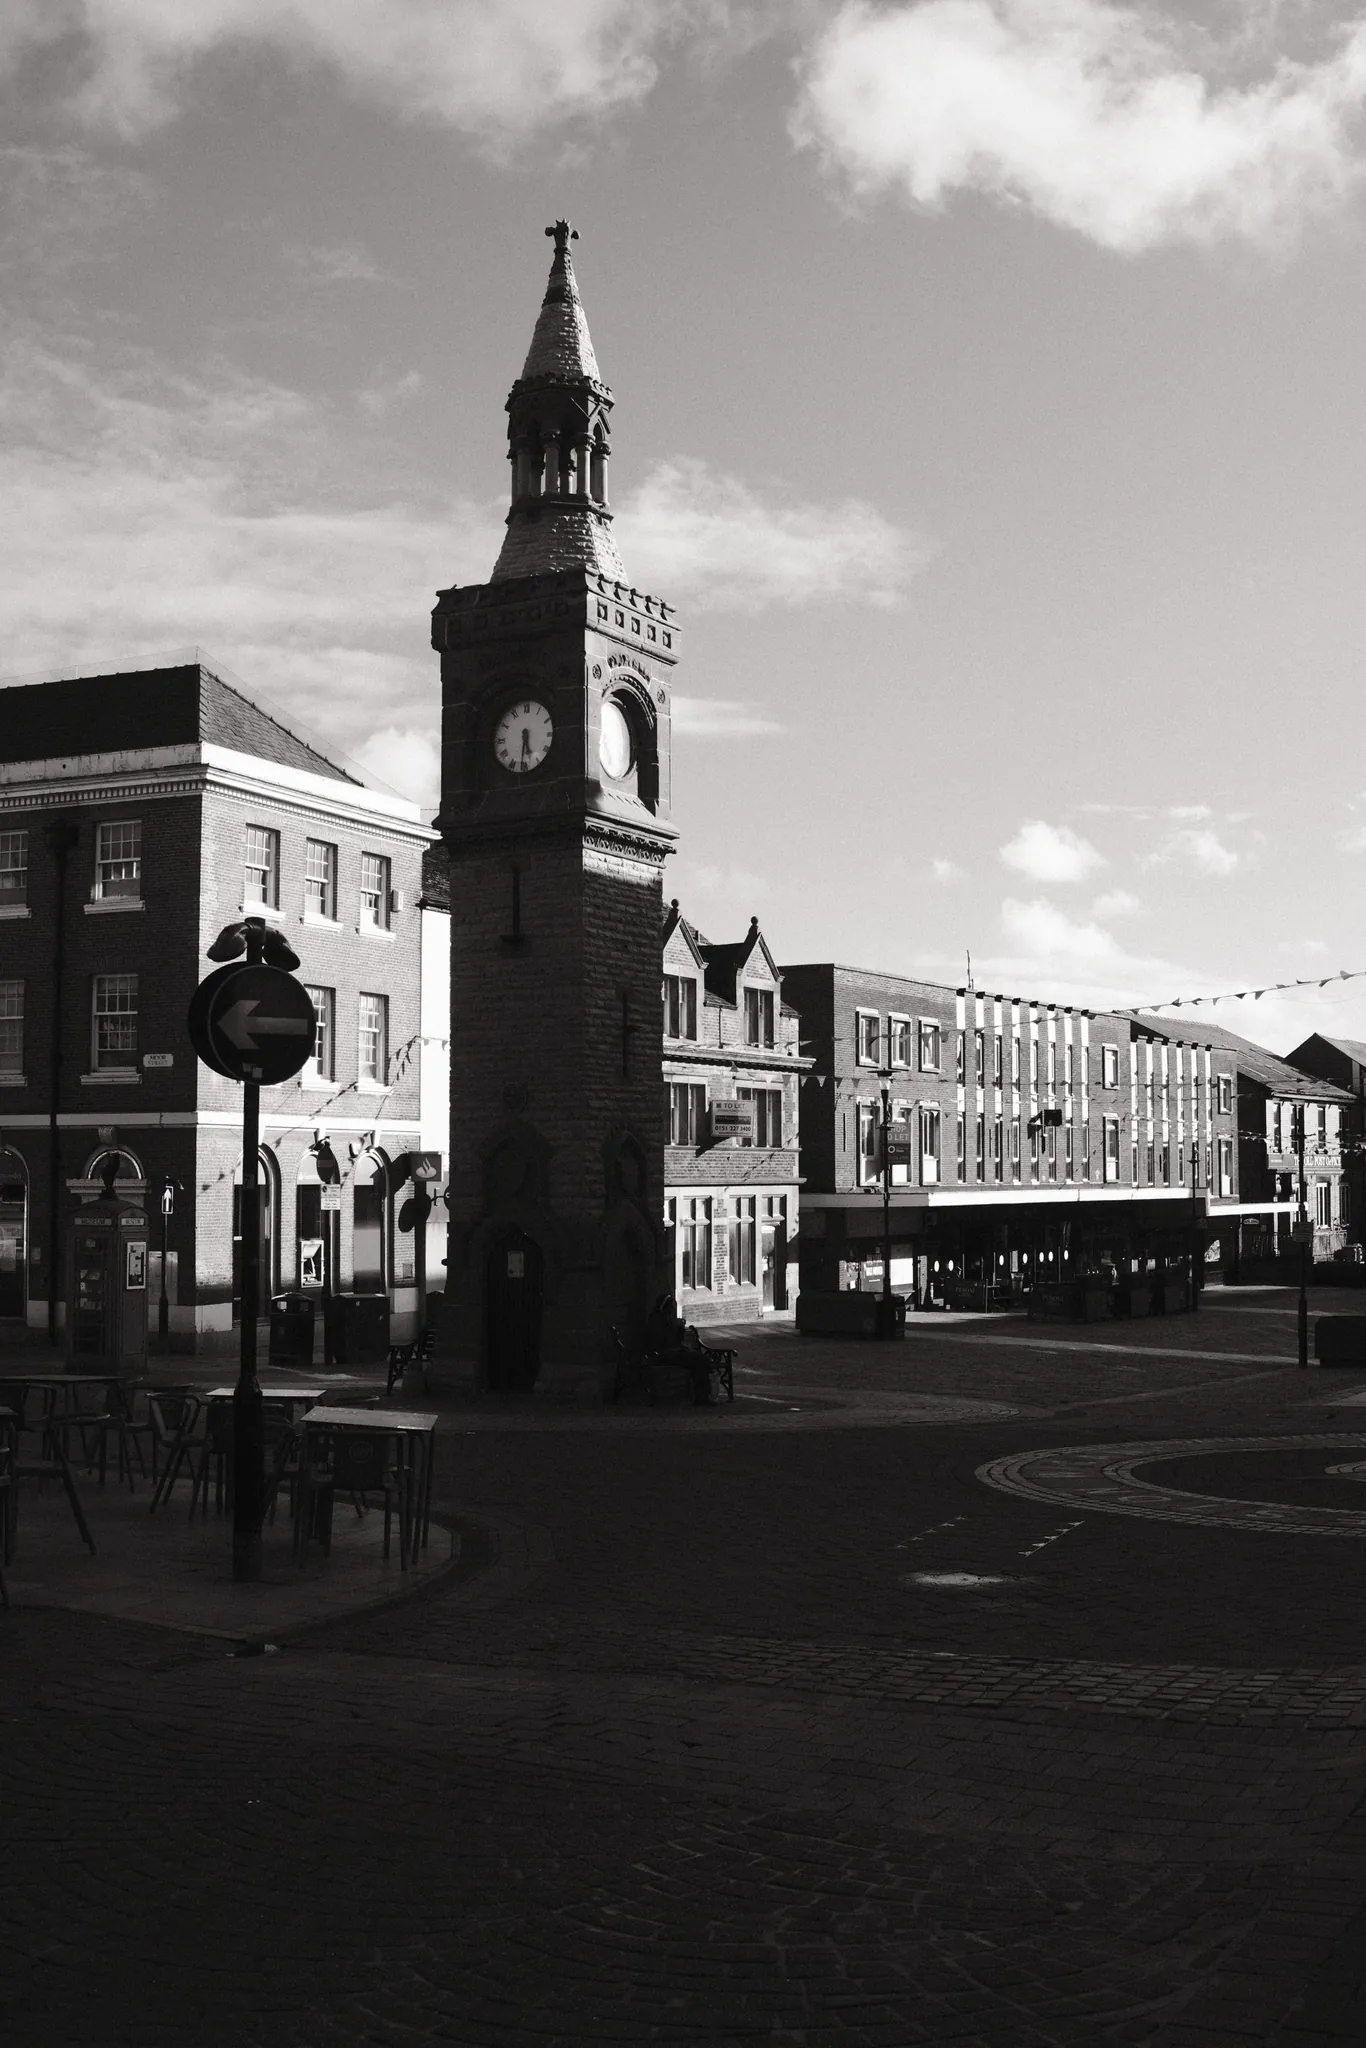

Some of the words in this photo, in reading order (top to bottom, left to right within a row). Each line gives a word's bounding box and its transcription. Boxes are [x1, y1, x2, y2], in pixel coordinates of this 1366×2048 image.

[894, 1133, 909, 1141] LET
[1304, 1156, 1315, 1166] OLD
[1315, 1156, 1326, 1166] POST
[1326, 1156, 1341, 1166] OFFICE
